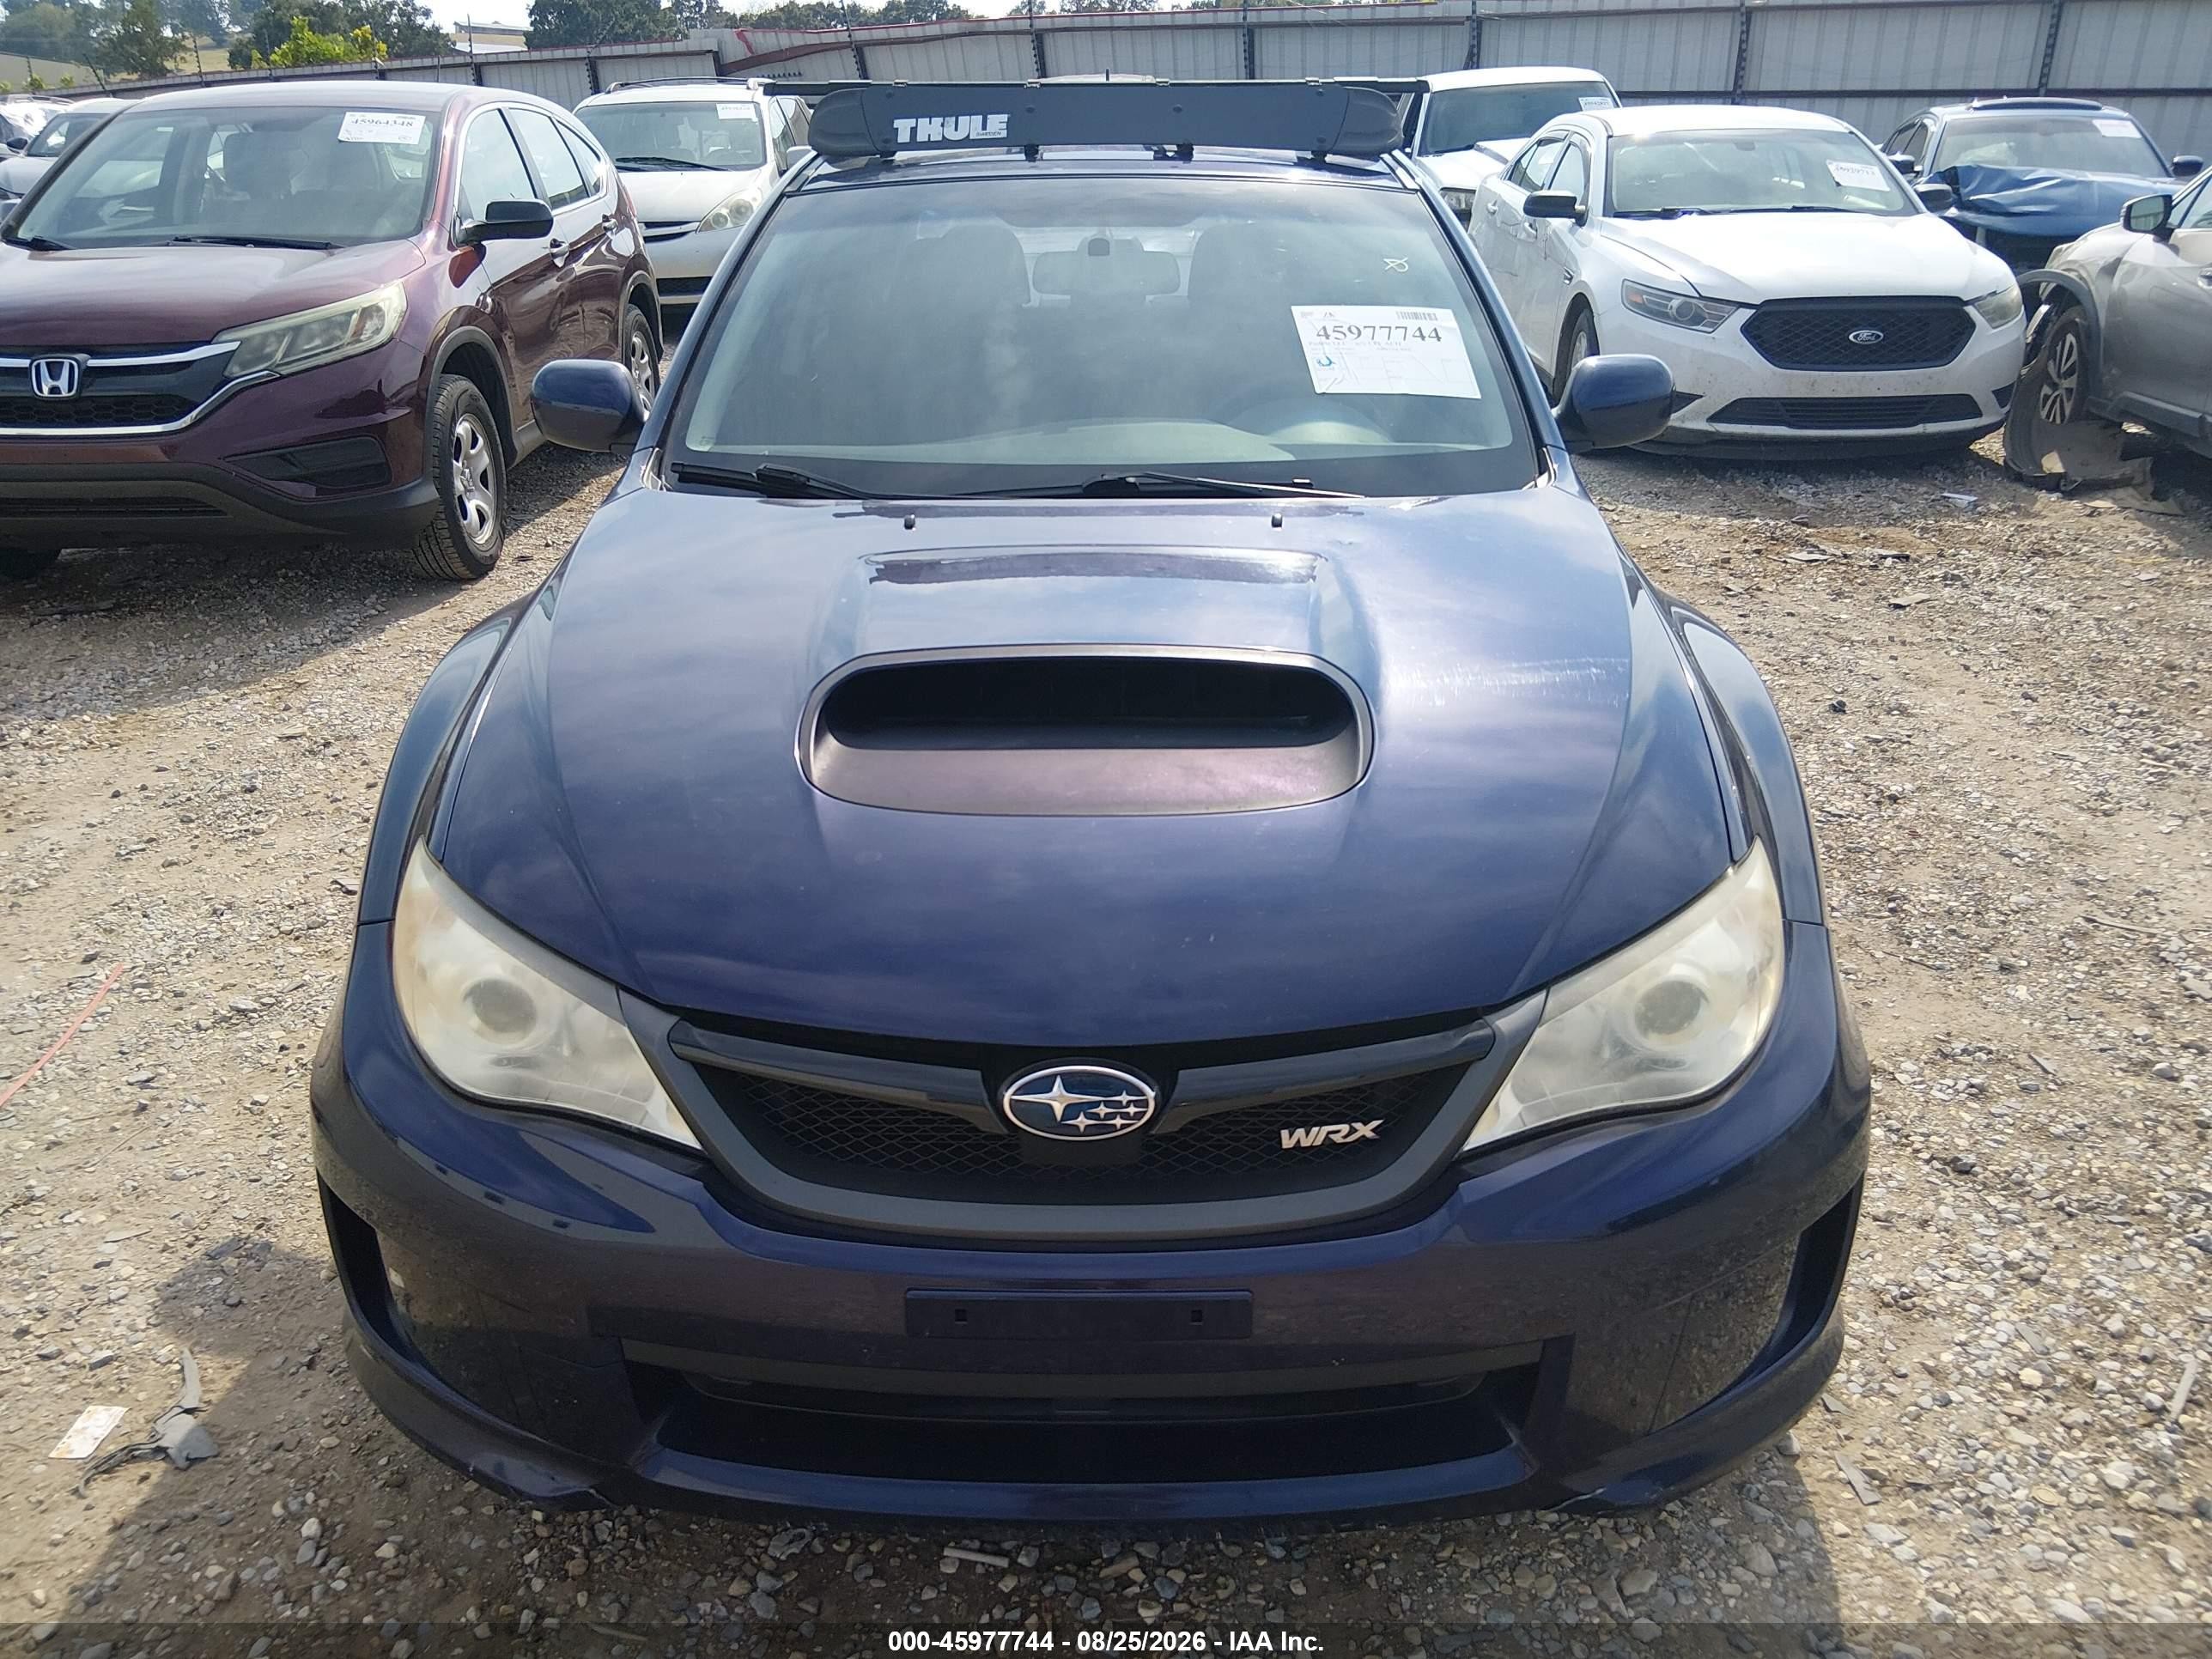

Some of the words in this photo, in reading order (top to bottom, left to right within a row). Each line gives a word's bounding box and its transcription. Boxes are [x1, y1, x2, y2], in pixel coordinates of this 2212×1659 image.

[893, 113, 1009, 143] THULE
[1316, 325, 1443, 343] 45977744
[1856, 332, 1875, 341] Ford
[1279, 1119, 1384, 1150] WRX
